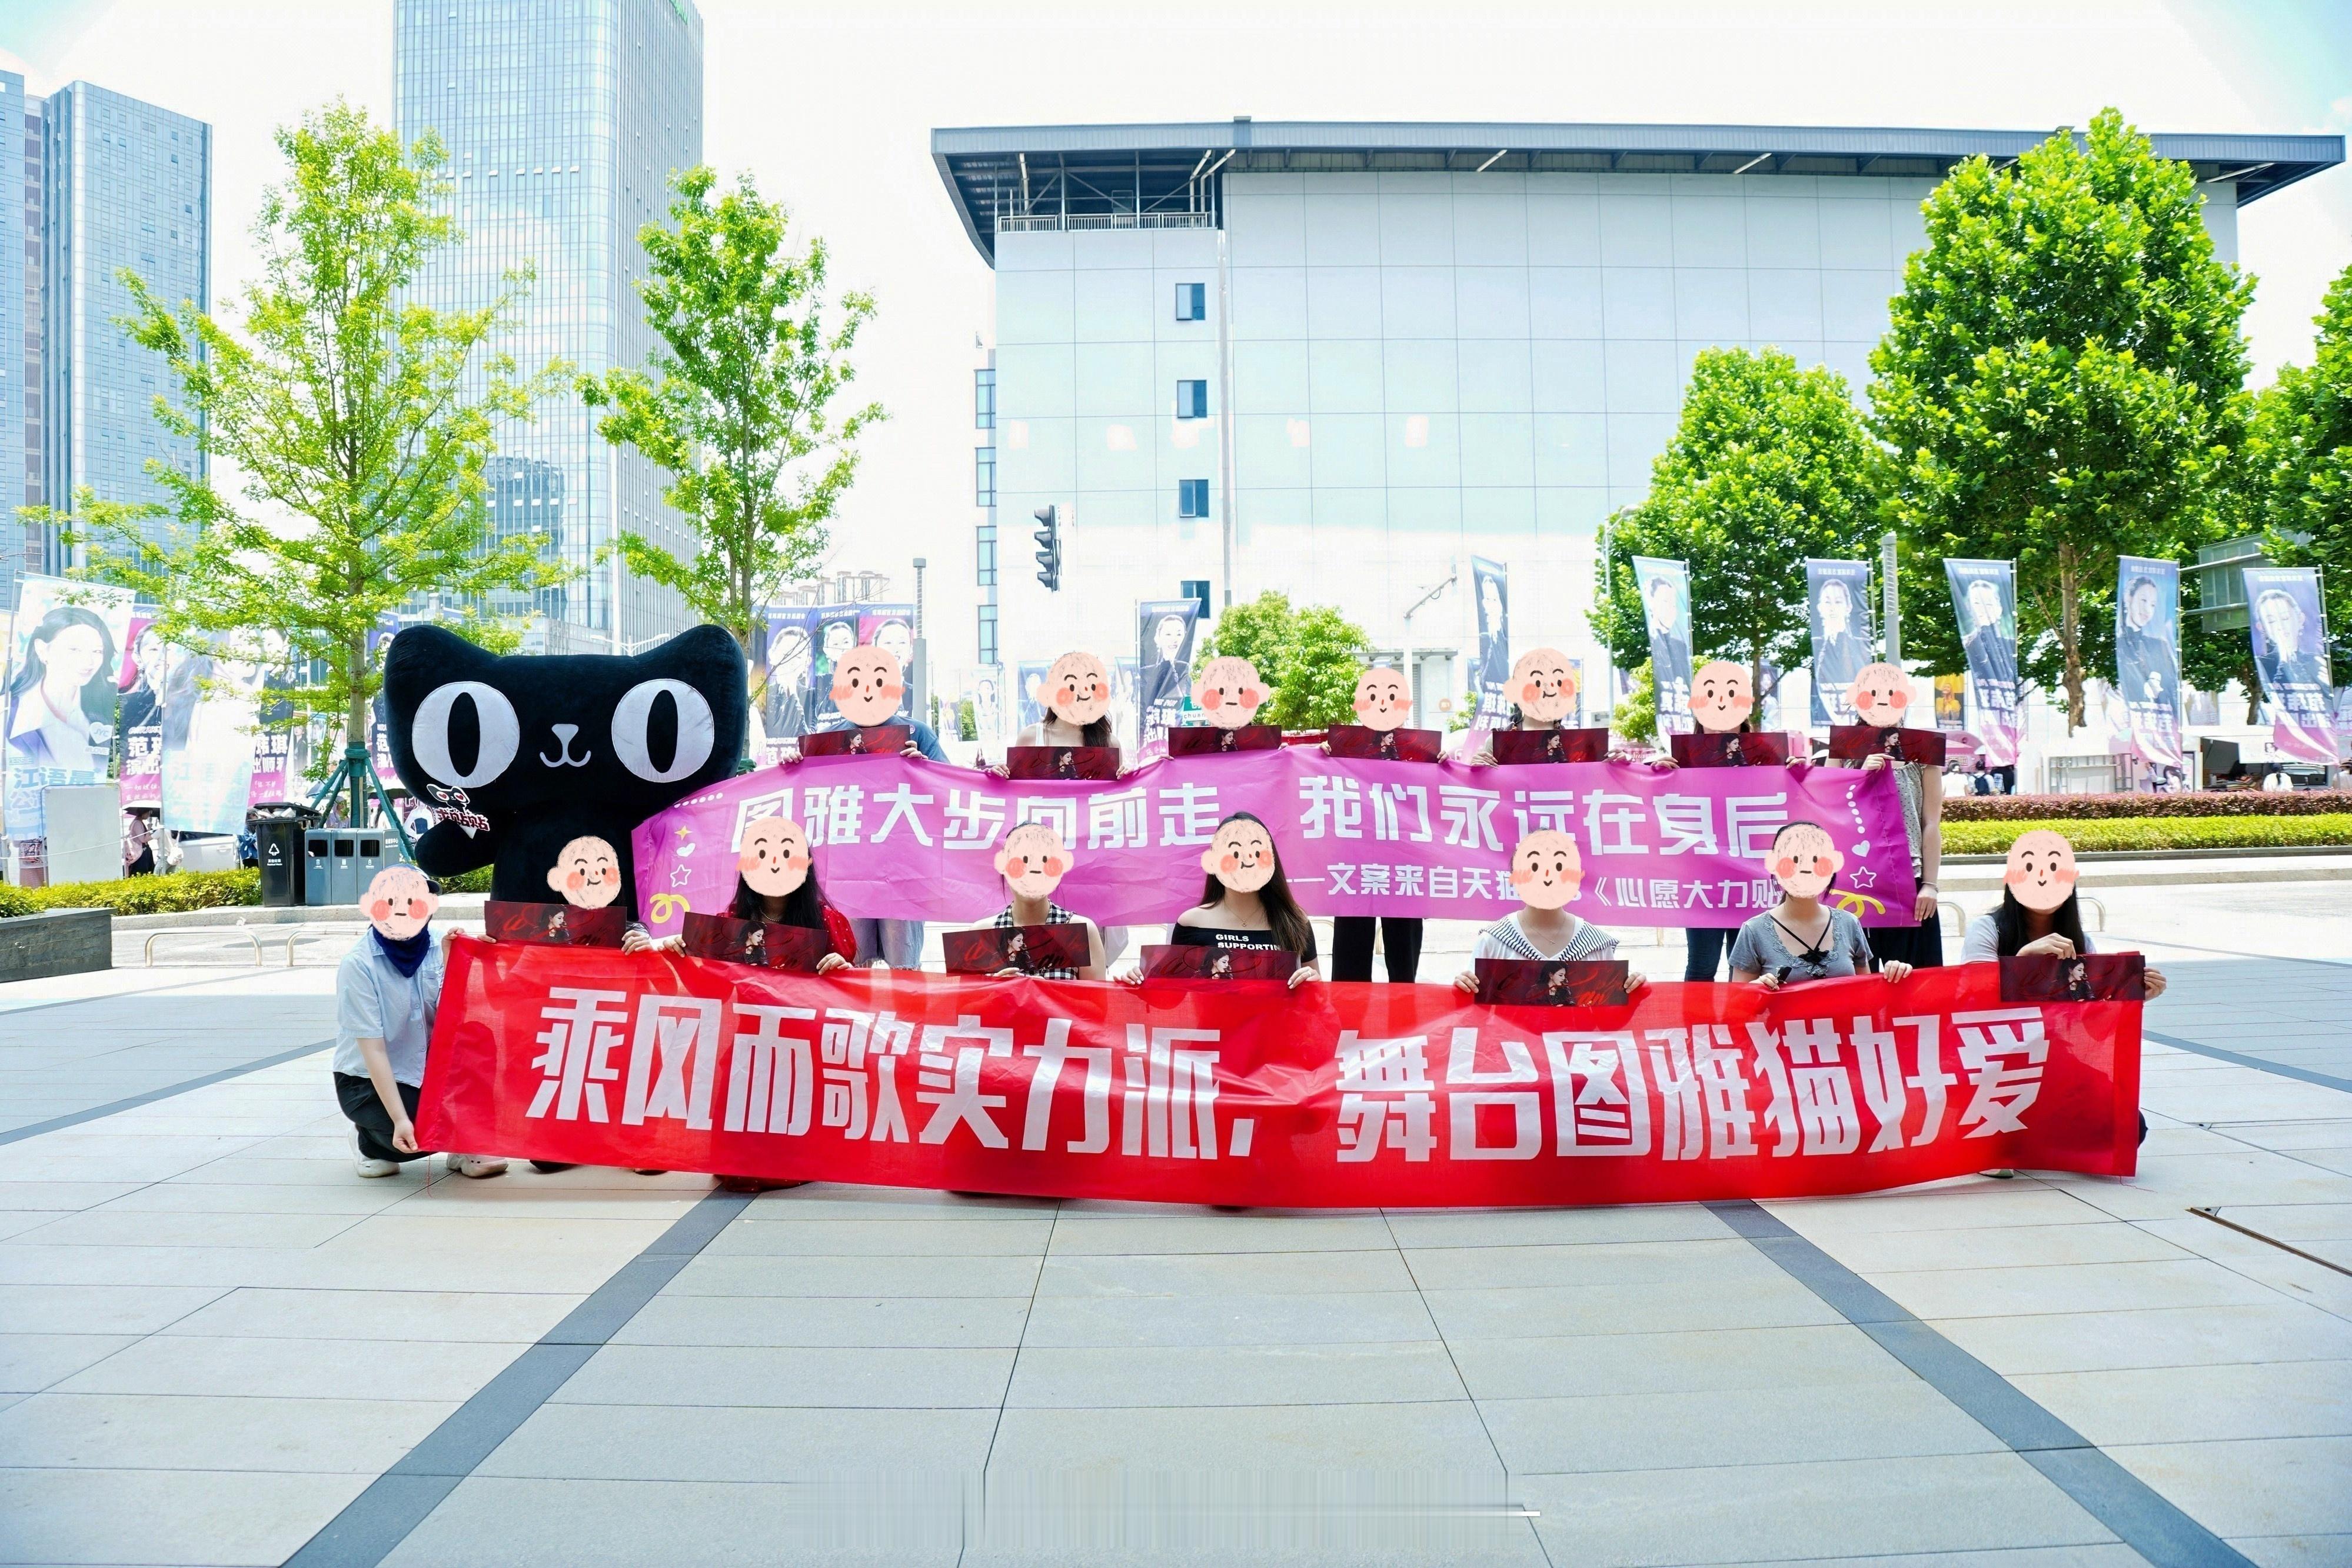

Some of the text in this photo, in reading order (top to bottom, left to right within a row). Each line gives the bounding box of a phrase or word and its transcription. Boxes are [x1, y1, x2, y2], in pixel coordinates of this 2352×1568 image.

[14, 767, 95, 789] 江语晨
[731, 775, 1788, 859] 图雅大步向前走 我们永远在身后
[1215, 934, 1249, 942] GIRLS
[1335, 1006, 2050, 1163] 舞台图雅猫好爱
